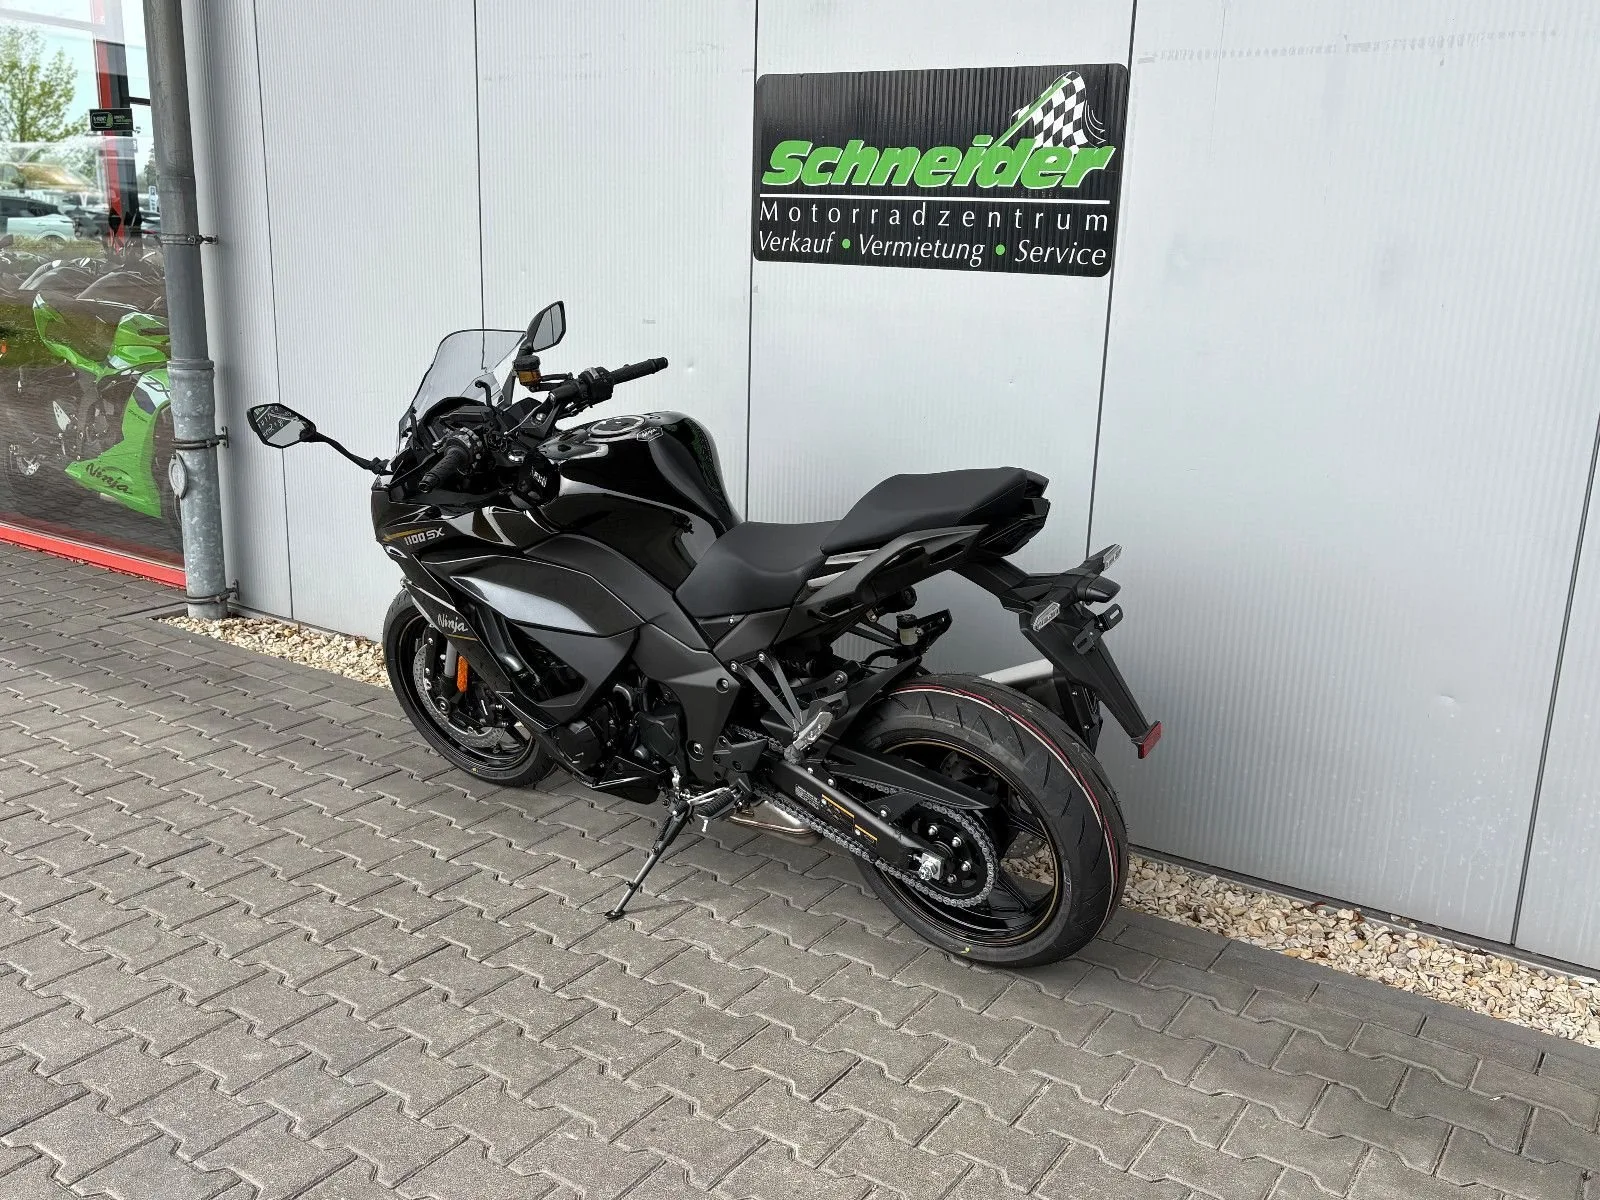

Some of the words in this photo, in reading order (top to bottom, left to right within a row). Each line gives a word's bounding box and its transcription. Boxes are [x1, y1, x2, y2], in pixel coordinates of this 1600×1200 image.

[761, 134, 1116, 188] Schneider
[759, 201, 1108, 232] Motorradzentrum
[758, 231, 835, 254] Verkauf
[858, 233, 986, 268] Vermietung
[1014, 239, 1107, 266] Service
[86, 463, 133, 494] Ninja
[437, 613, 468, 634] Ninja
